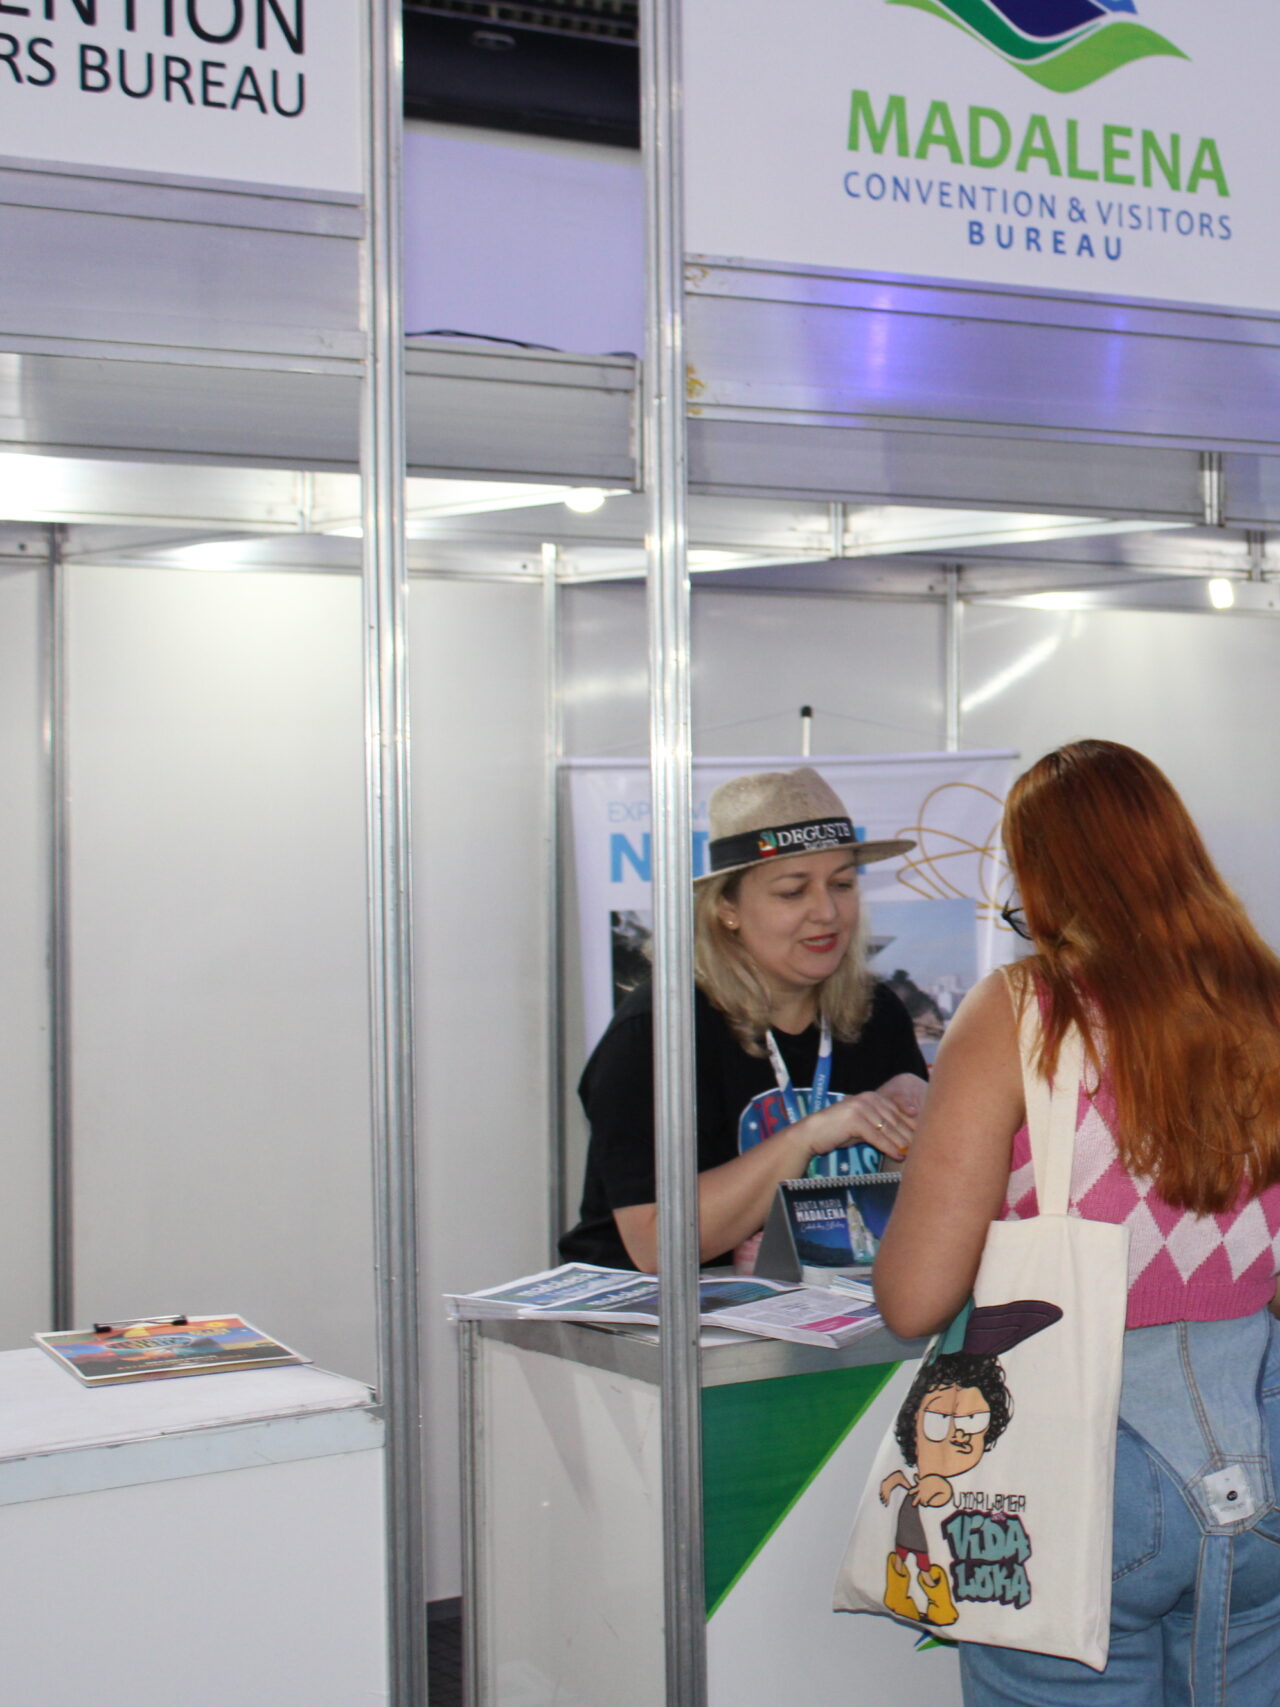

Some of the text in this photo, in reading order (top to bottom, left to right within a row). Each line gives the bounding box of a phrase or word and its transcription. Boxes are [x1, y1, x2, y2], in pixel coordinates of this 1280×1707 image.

[79, 43, 305, 118] BUREAU
[847, 89, 1231, 198] MADALENA
[843, 171, 1233, 241] CONVENTION & VISITORS
[967, 220, 1123, 261] BUREAU
[776, 822, 851, 847] DEGUSTE
[796, 1208, 847, 1222] MADALENA
